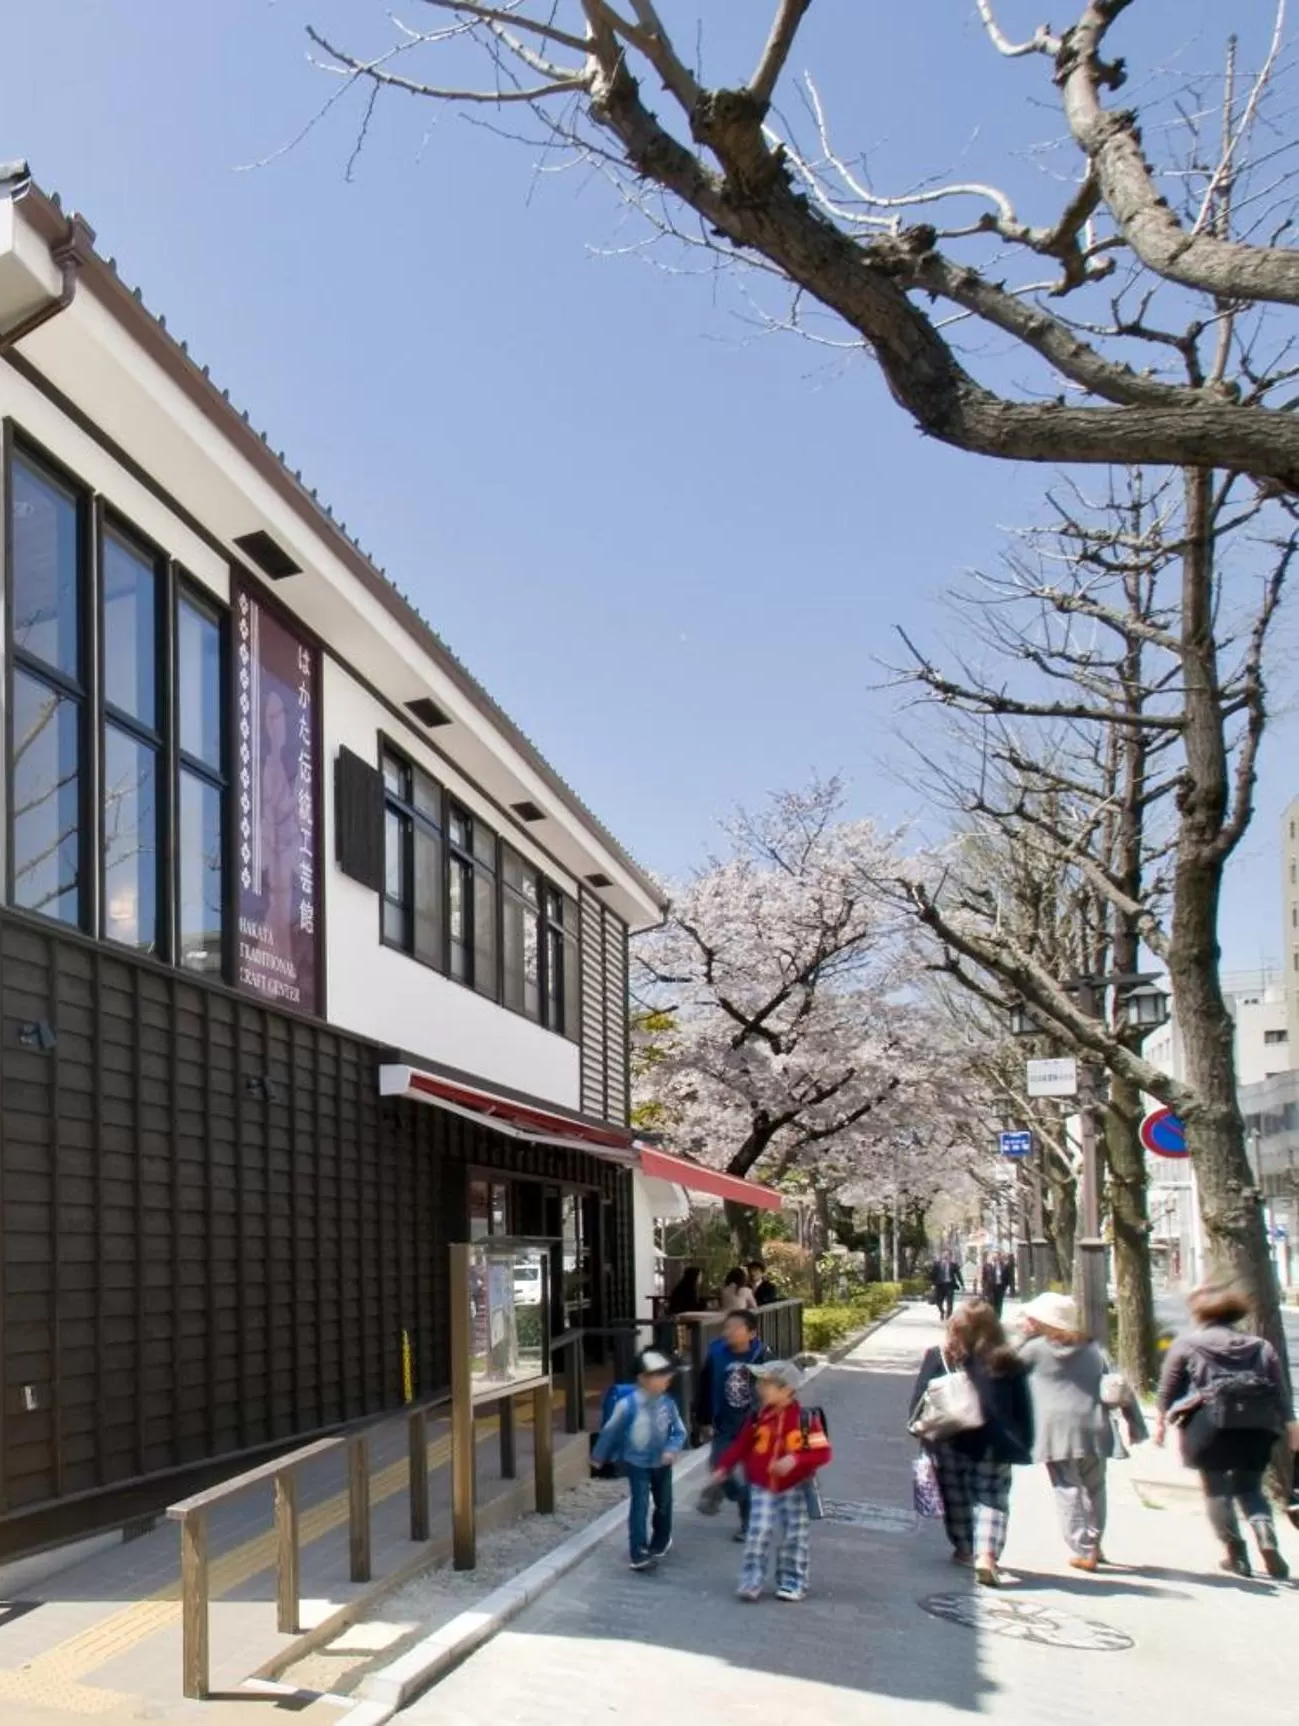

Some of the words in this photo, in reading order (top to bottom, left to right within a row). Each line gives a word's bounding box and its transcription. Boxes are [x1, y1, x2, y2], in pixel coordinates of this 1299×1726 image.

[298, 644, 313, 934] はかた伝統工芸館
